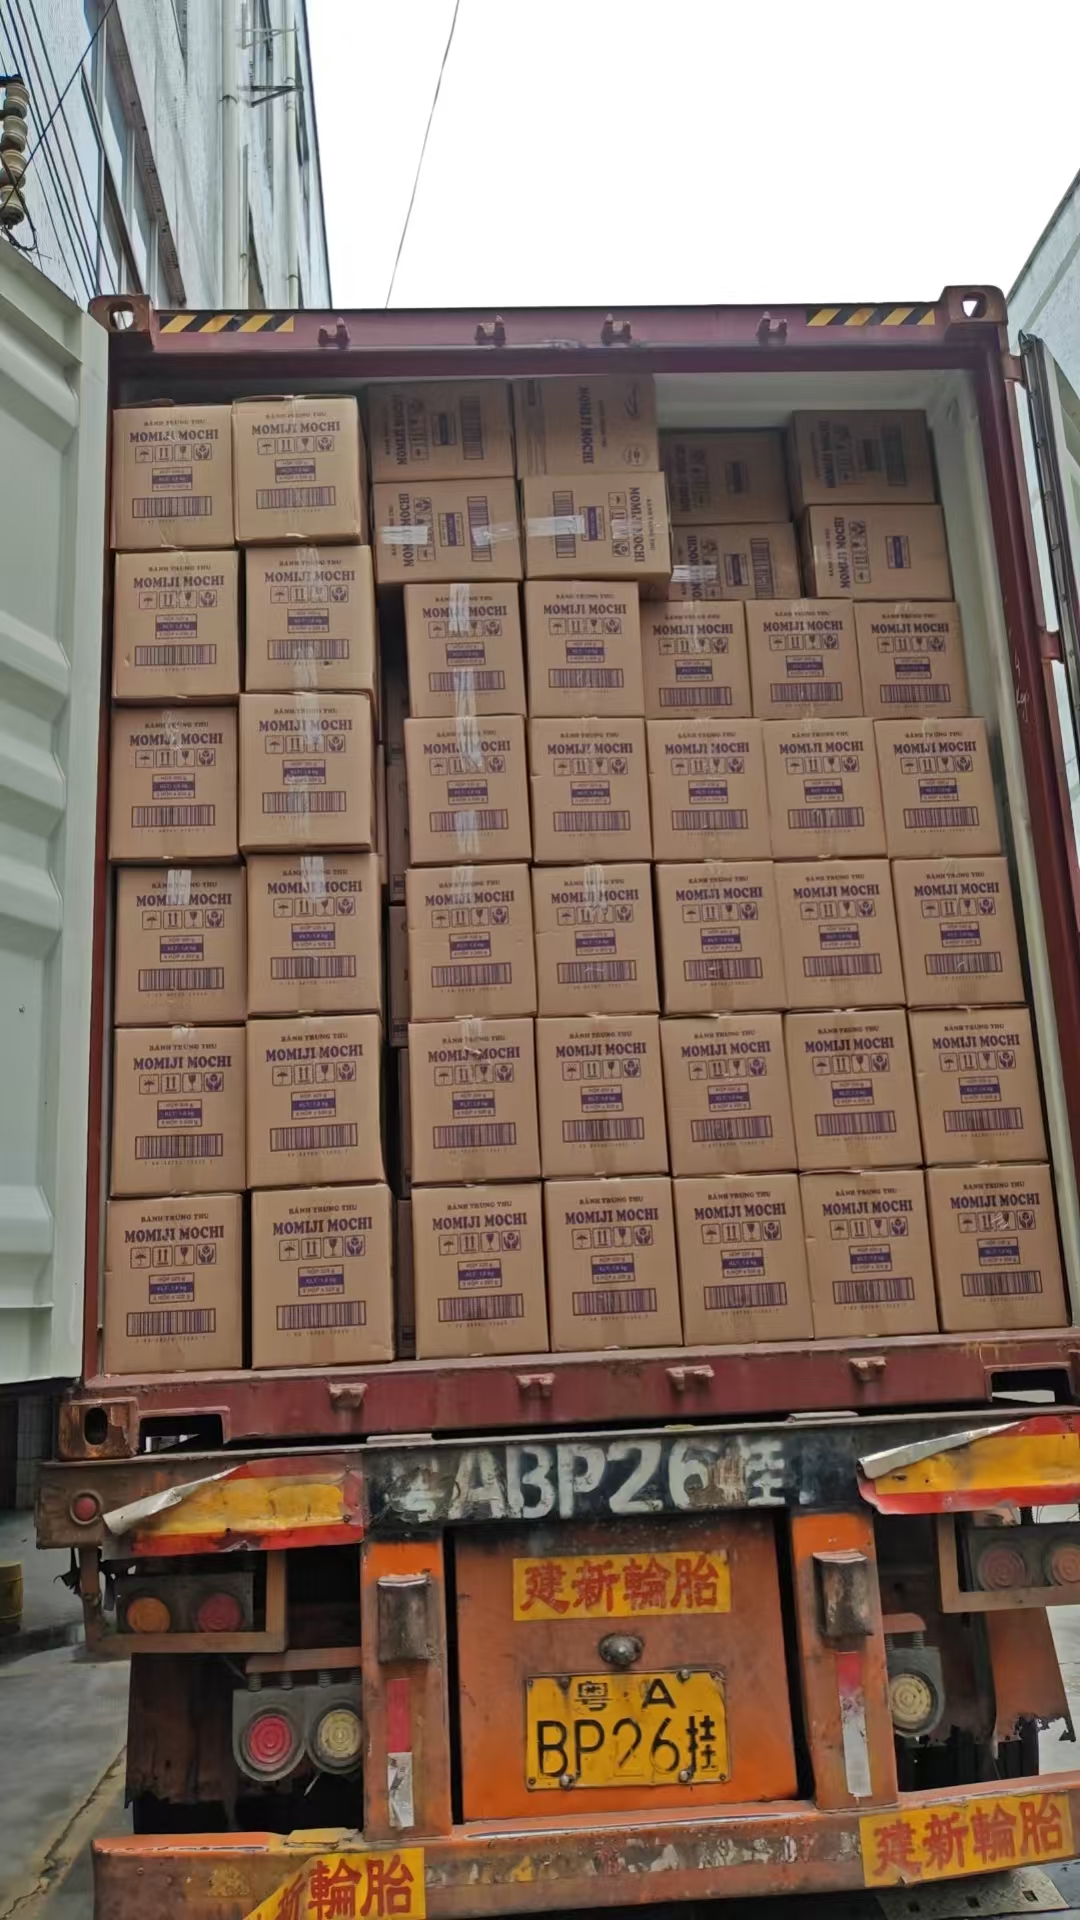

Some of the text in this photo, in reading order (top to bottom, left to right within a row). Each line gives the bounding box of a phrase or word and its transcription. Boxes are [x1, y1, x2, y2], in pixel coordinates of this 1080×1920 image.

[178, 428, 218, 442] MOCHI
[252, 420, 340, 436] MOMIJI MOCHI
[580, 428, 594, 464] MOCHI
[399, 493, 411, 528] MOCHI
[834, 516, 847, 550] MOCHI
[134, 574, 224, 589] MOMIJI MOCHI
[314, 570, 355, 582] MOCHI
[469, 604, 507, 618] MOCHI
[543, 603, 627, 616] MOMIJI MOCHI
[653, 623, 733, 636] MOMIJI MOCHI
[763, 620, 843, 632] MOMIJI MOCHI
[871, 622, 949, 634] MOMIJI MOCHI
[259, 719, 352, 733] MOMIJI MOCHI
[181, 732, 223, 746] MOCHI
[423, 740, 511, 754] MOMI OCHI
[595, 742, 633, 754] MOCHI
[665, 742, 749, 754] MOMIJI MOCHI
[779, 740, 864, 755] MOMIJI MOCHI
[893, 740, 976, 756] MOMIJI MOCHI
[268, 881, 316, 894] MOMIJ
[676, 886, 763, 902] MOMIJI MOCHI
[793, 884, 880, 900] MOMIJI MOCHI
[914, 882, 999, 898] MOMIJI MOCHI
[189, 892, 232, 906] MOCHI
[425, 890, 514, 906] MOMIJI MOCHI
[556, 1042, 646, 1058] MOMIJI MOCHI
[681, 1040, 771, 1058] MOMIJI MOCHI
[805, 1036, 894, 1054] MOMIJI MOCHI
[932, 1034, 1020, 1050] MOMIJI MOCHI
[266, 1044, 364, 1062] MOMIJI MOCHI
[428, 1048, 474, 1064] MOMIJ
[133, 1055, 232, 1071] MOMIJI MOCHI
[822, 1200, 913, 1216] MOMIJI MOCHI
[950, 1192, 1040, 1210] MOMIJI MOCHI
[565, 1208, 658, 1226] MOMIJI MOCHI
[694, 1202, 786, 1220] MOMIJI MOCHI
[273, 1216, 372, 1236] MOMIJI MOCHI
[432, 1212, 527, 1230] MOMIJI MOCHI
[125, 1224, 224, 1244] MOMIJI MOCHI
[520, 1556, 719, 1613] 建新輪胎
[537, 1715, 716, 1777] BP26挂
[872, 1793, 1063, 1876] 建新輪胎
